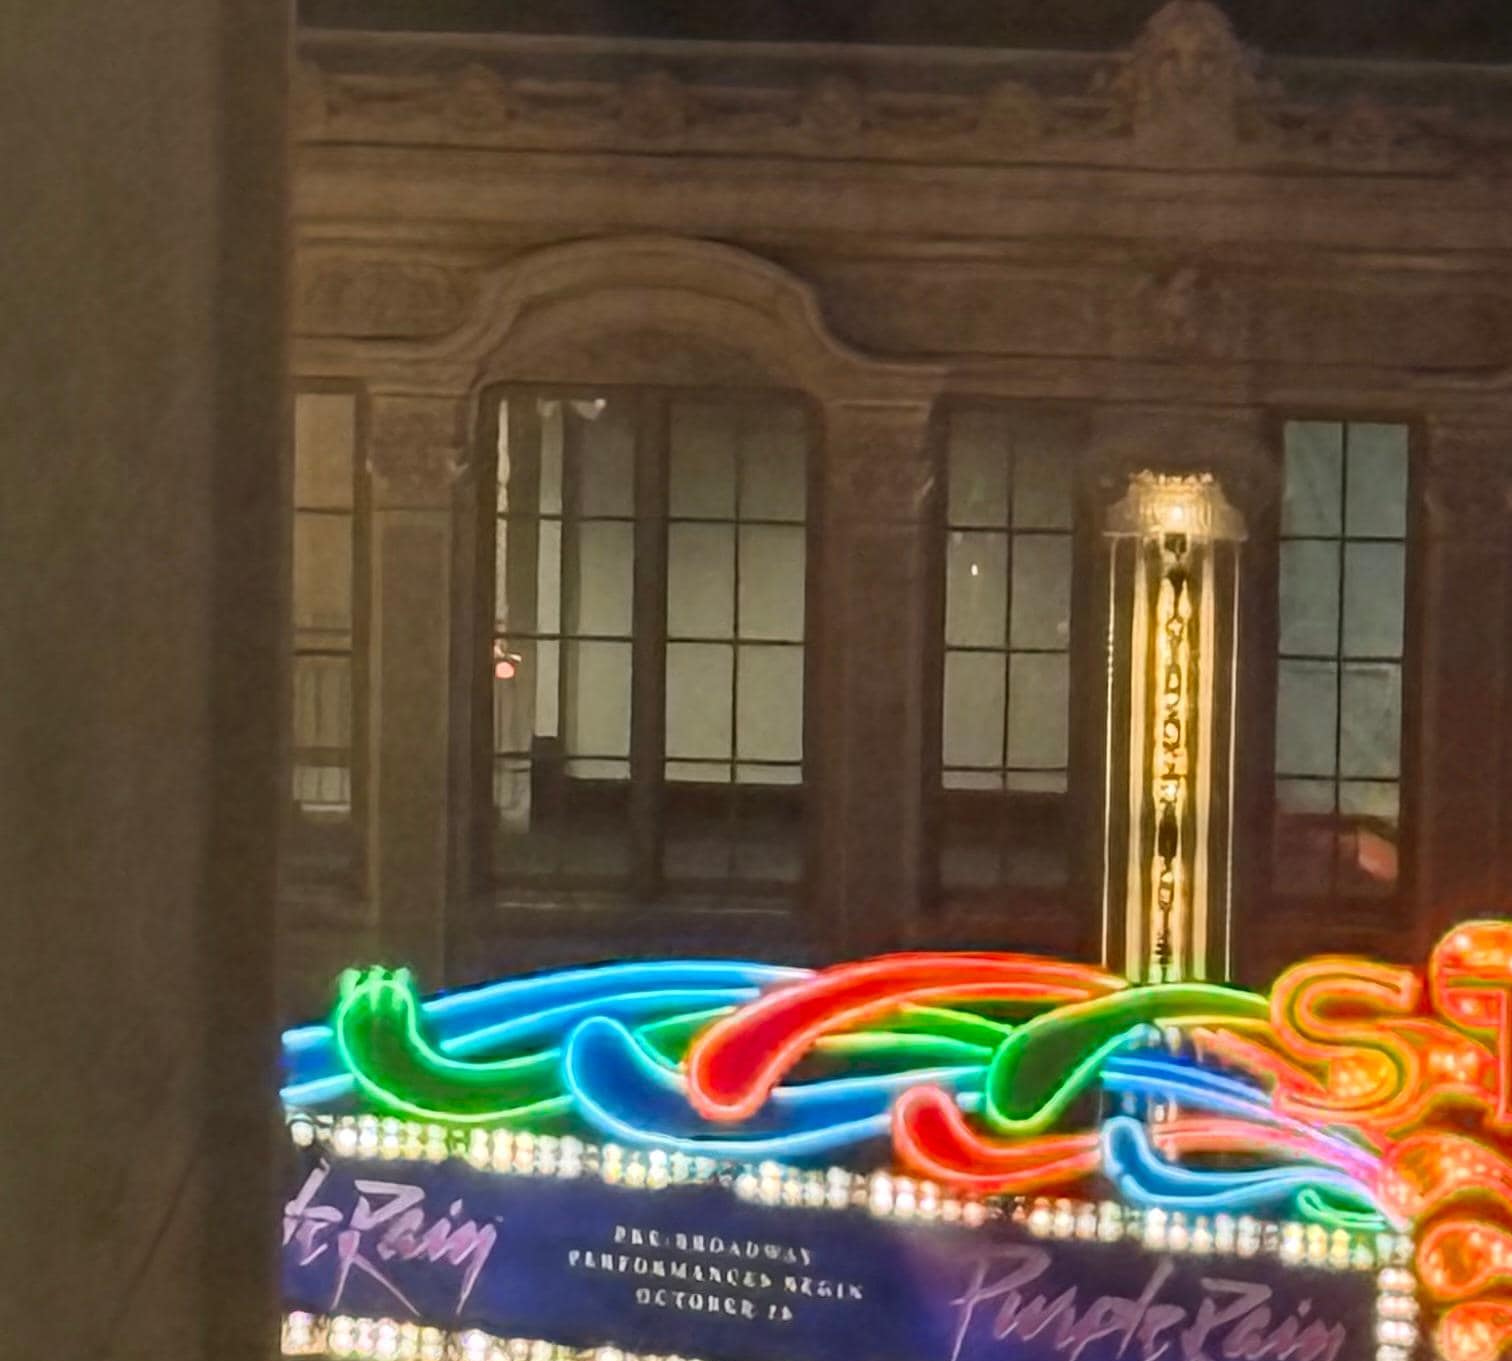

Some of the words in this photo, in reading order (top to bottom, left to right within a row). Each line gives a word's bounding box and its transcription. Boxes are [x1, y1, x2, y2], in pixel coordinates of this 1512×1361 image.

[330, 1179, 500, 1318] Rain
[568, 1249, 773, 1288] PERFORMANCES
[783, 1275, 864, 1300] BEGIN
[635, 1287, 756, 1320] OCTOBER
